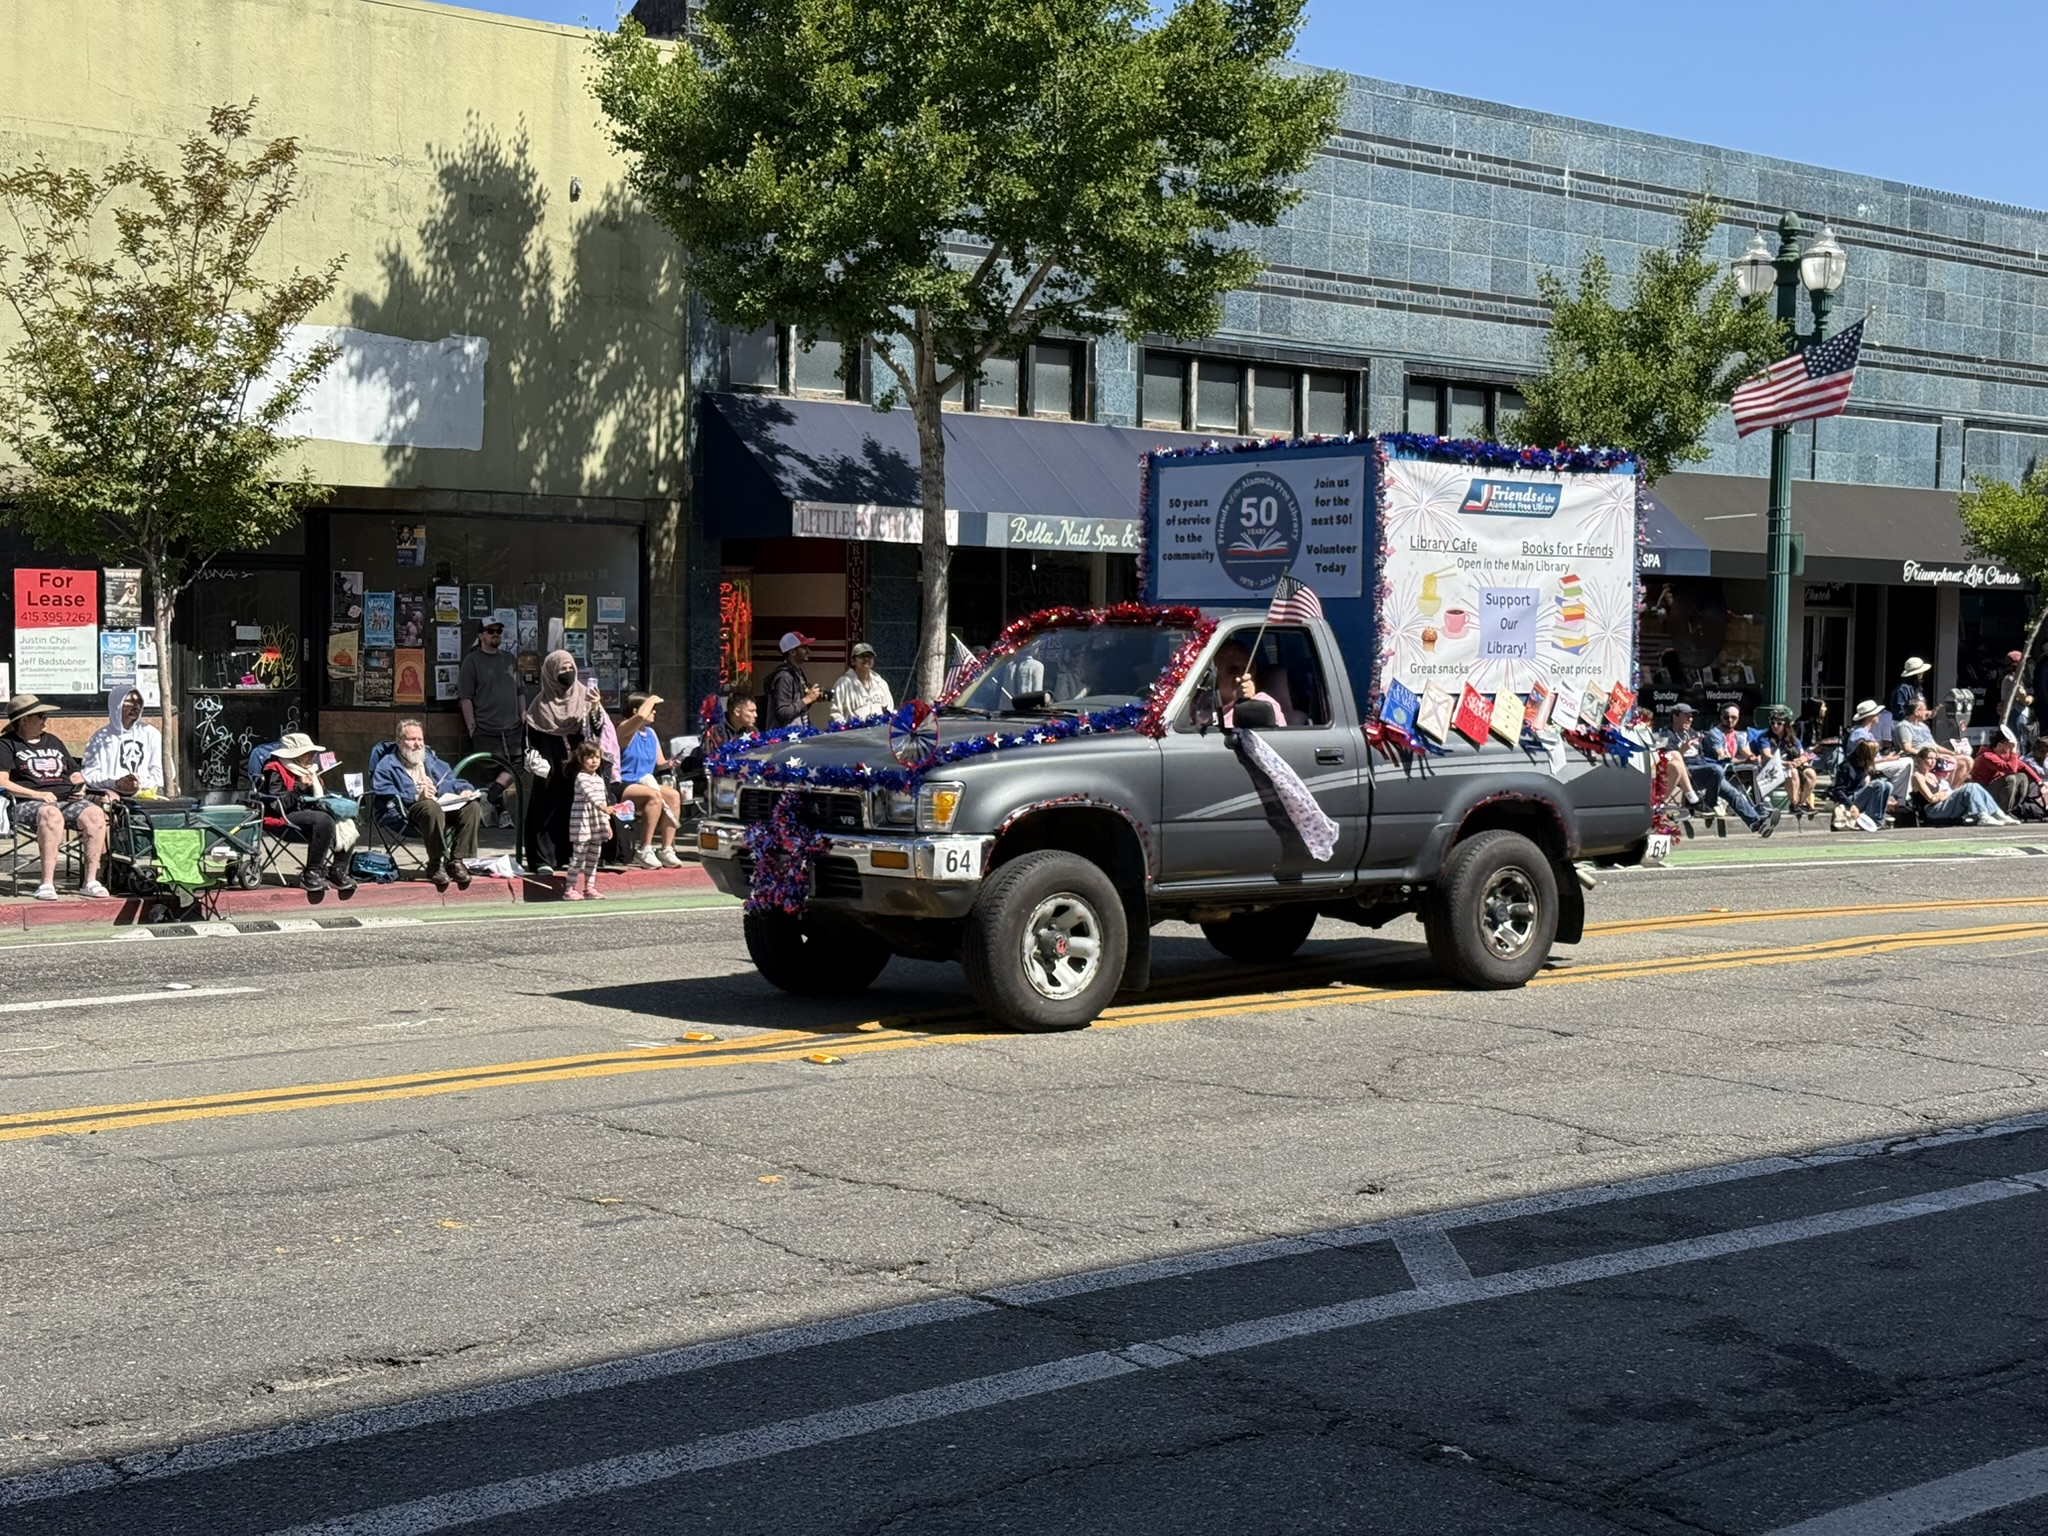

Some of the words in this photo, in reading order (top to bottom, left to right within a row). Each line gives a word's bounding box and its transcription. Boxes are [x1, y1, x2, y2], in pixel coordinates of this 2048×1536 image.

[1314, 477, 1335, 489] Join
[1337, 478, 1349, 488] us
[1490, 483, 1538, 503] Friends
[1169, 498, 1181, 508] 50
[1182, 499, 1209, 511] years
[1315, 496, 1332, 507] for
[1333, 496, 1350, 506] the
[1489, 500, 1517, 511] Alameda
[1518, 502, 1532, 511] Free
[1533, 502, 1555, 513] Library
[1218, 505, 1231, 545] Friends
[1241, 477, 1275, 490] Alameda
[1275, 481, 1291, 501] Free
[1286, 500, 1299, 541] Library
[1240, 496, 1278, 527] 50
[799, 508, 850, 536] LITTLE
[1165, 515, 1176, 526] of
[1177, 514, 1211, 525] service
[1311, 515, 1334, 526] next
[1335, 513, 1353, 525] 50!
[1010, 516, 1054, 545] Bella
[1053, 519, 1090, 546] Nail
[1091, 524, 1118, 551] Spa
[1121, 523, 1136, 548] &
[1175, 534, 1186, 543] to
[1187, 532, 1203, 543] the
[1247, 528, 1267, 536] YEARS
[1306, 544, 1358, 555] Volunteer
[1409, 535, 1449, 552] Library
[1452, 537, 1478, 552] Cafe
[1521, 541, 1555, 556] Books
[1556, 541, 1574, 556] for
[1576, 543, 1614, 557] Friends
[1162, 549, 1215, 563] community
[1642, 553, 1661, 568] SPA
[1315, 562, 1347, 576] Today
[1456, 556, 1481, 571] Open
[1483, 557, 1493, 569] in
[1494, 557, 1510, 571] the
[1511, 559, 1534, 572] Main
[1535, 560, 1571, 574] Library
[1903, 559, 1962, 585] Triumphant
[1963, 564, 1984, 588] Life
[1984, 565, 2021, 585] Church
[39, 572, 74, 589] For
[27, 590, 86, 608] Lease
[567, 598, 584, 606] IMP
[1485, 592, 1531, 607] Support
[20, 611, 93, 623] 415.395.7262
[1500, 618, 1518, 631] Our
[19, 635, 47, 645] Justin
[49, 635, 70, 645] Choi
[1486, 641, 1527, 657] Library!
[19, 657, 36, 667] Jeff
[38, 657, 87, 667] Badstubner
[1410, 663, 1437, 675] Great
[1438, 663, 1469, 676] snacks
[1550, 664, 1573, 675] Great
[1574, 664, 1602, 677] prices
[82, 682, 95, 691] JLL
[1653, 690, 1679, 704] Sunday
[1706, 690, 1743, 702] Wednesday
[1655, 703, 1665, 713] 10
[15, 749, 38, 762] OLD
[36, 748, 64, 759] NAVY
[839, 815, 856, 826] V6
[1652, 840, 1668, 859] 64
[945, 850, 971, 873] 64
